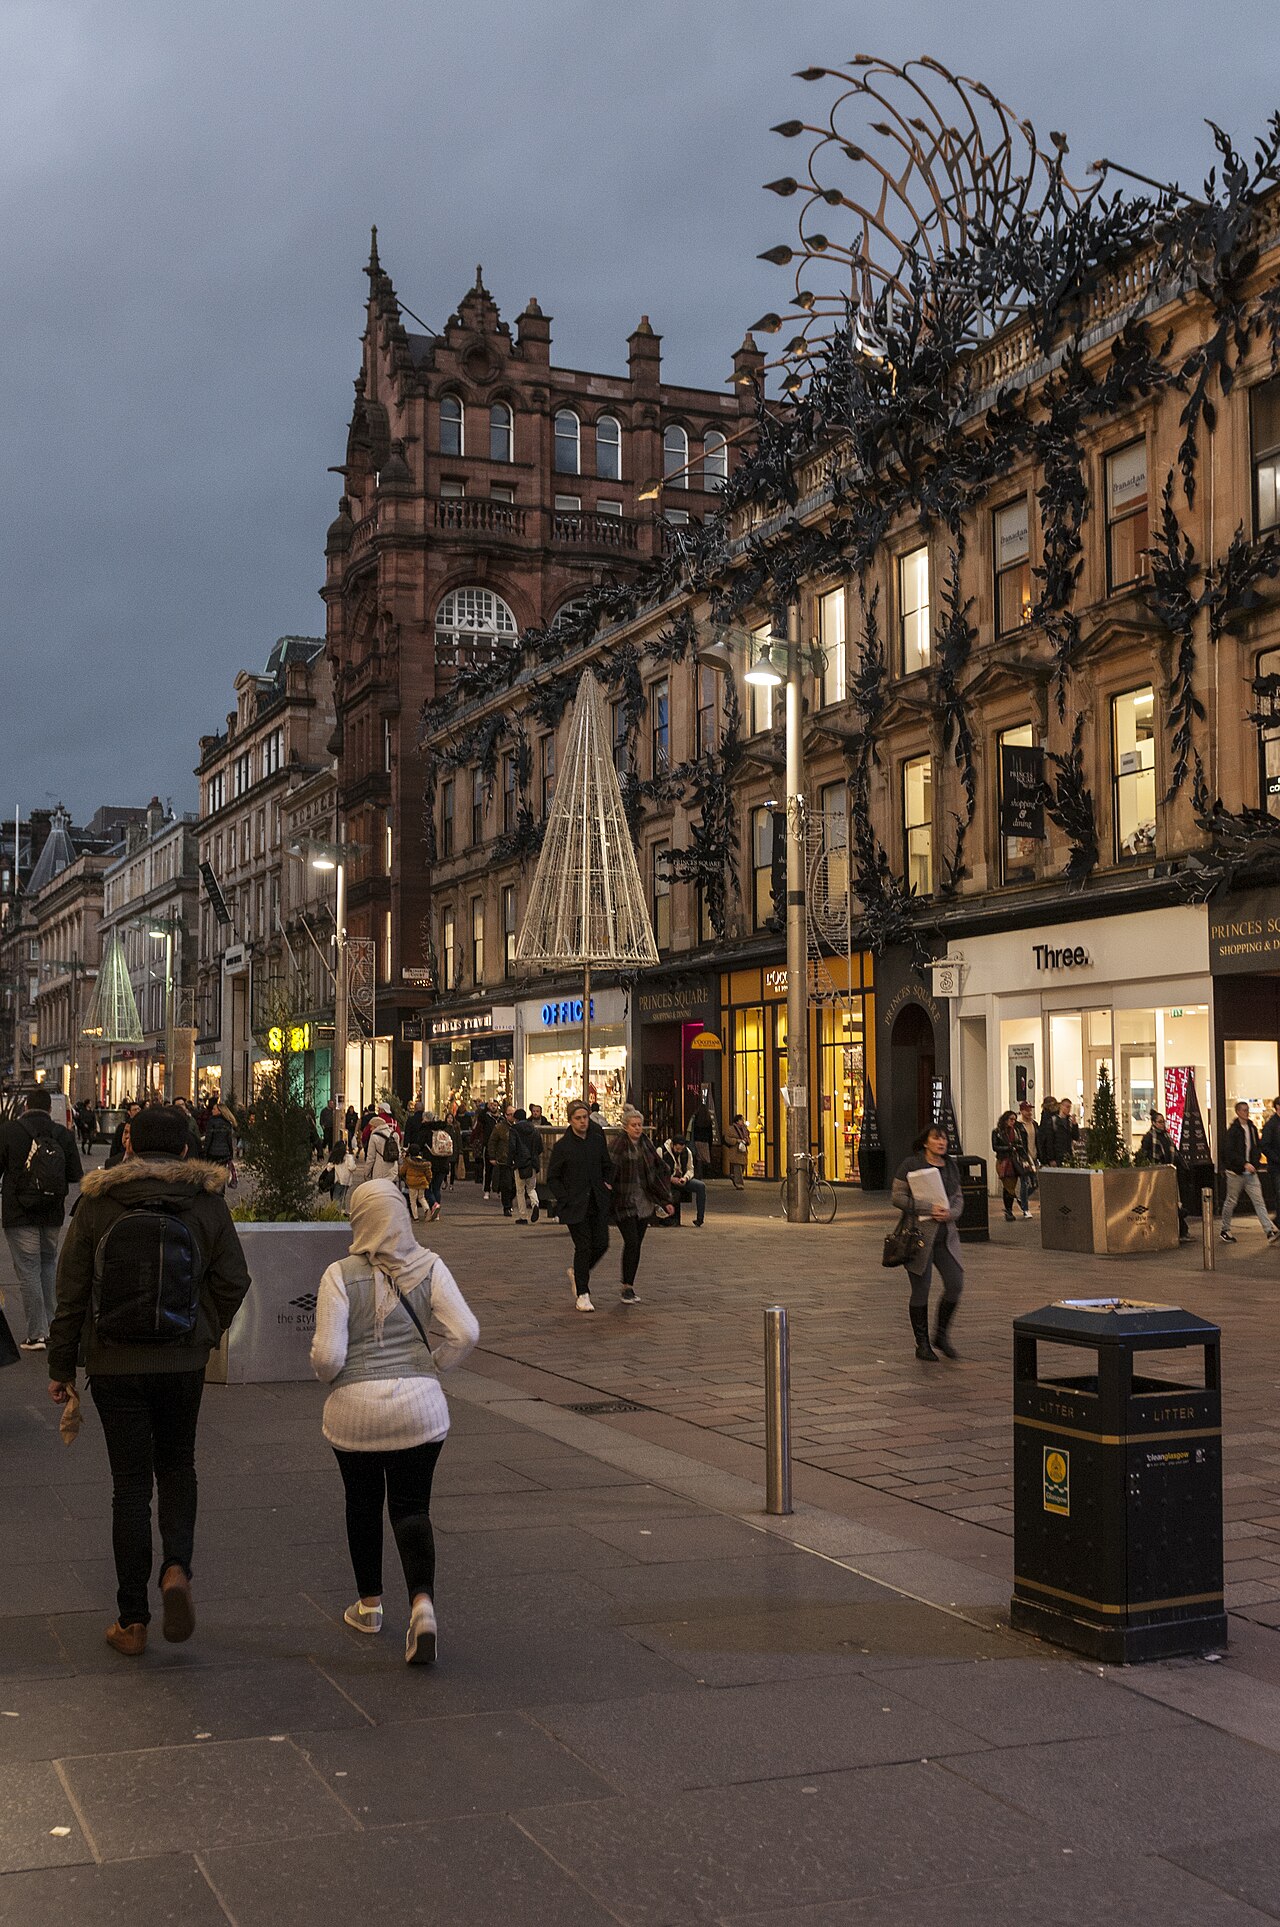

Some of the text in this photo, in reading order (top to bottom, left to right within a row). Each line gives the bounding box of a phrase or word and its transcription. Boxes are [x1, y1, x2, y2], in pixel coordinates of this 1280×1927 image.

[1010, 798, 1036, 810] shopping
[1012, 818, 1032, 829] dining
[1211, 920, 1262, 940] PRINCES
[1219, 941, 1262, 956] SHOPPING
[1263, 940, 1271, 951] &
[1032, 944, 1089, 970] Three.
[639, 988, 709, 1011] PRINCES SQUARE
[432, 1019, 462, 1034] CHARLES
[277, 1313, 294, 1324] the
[1039, 1402, 1074, 1419] LITTER
[1153, 1407, 1195, 1422] LITTER
